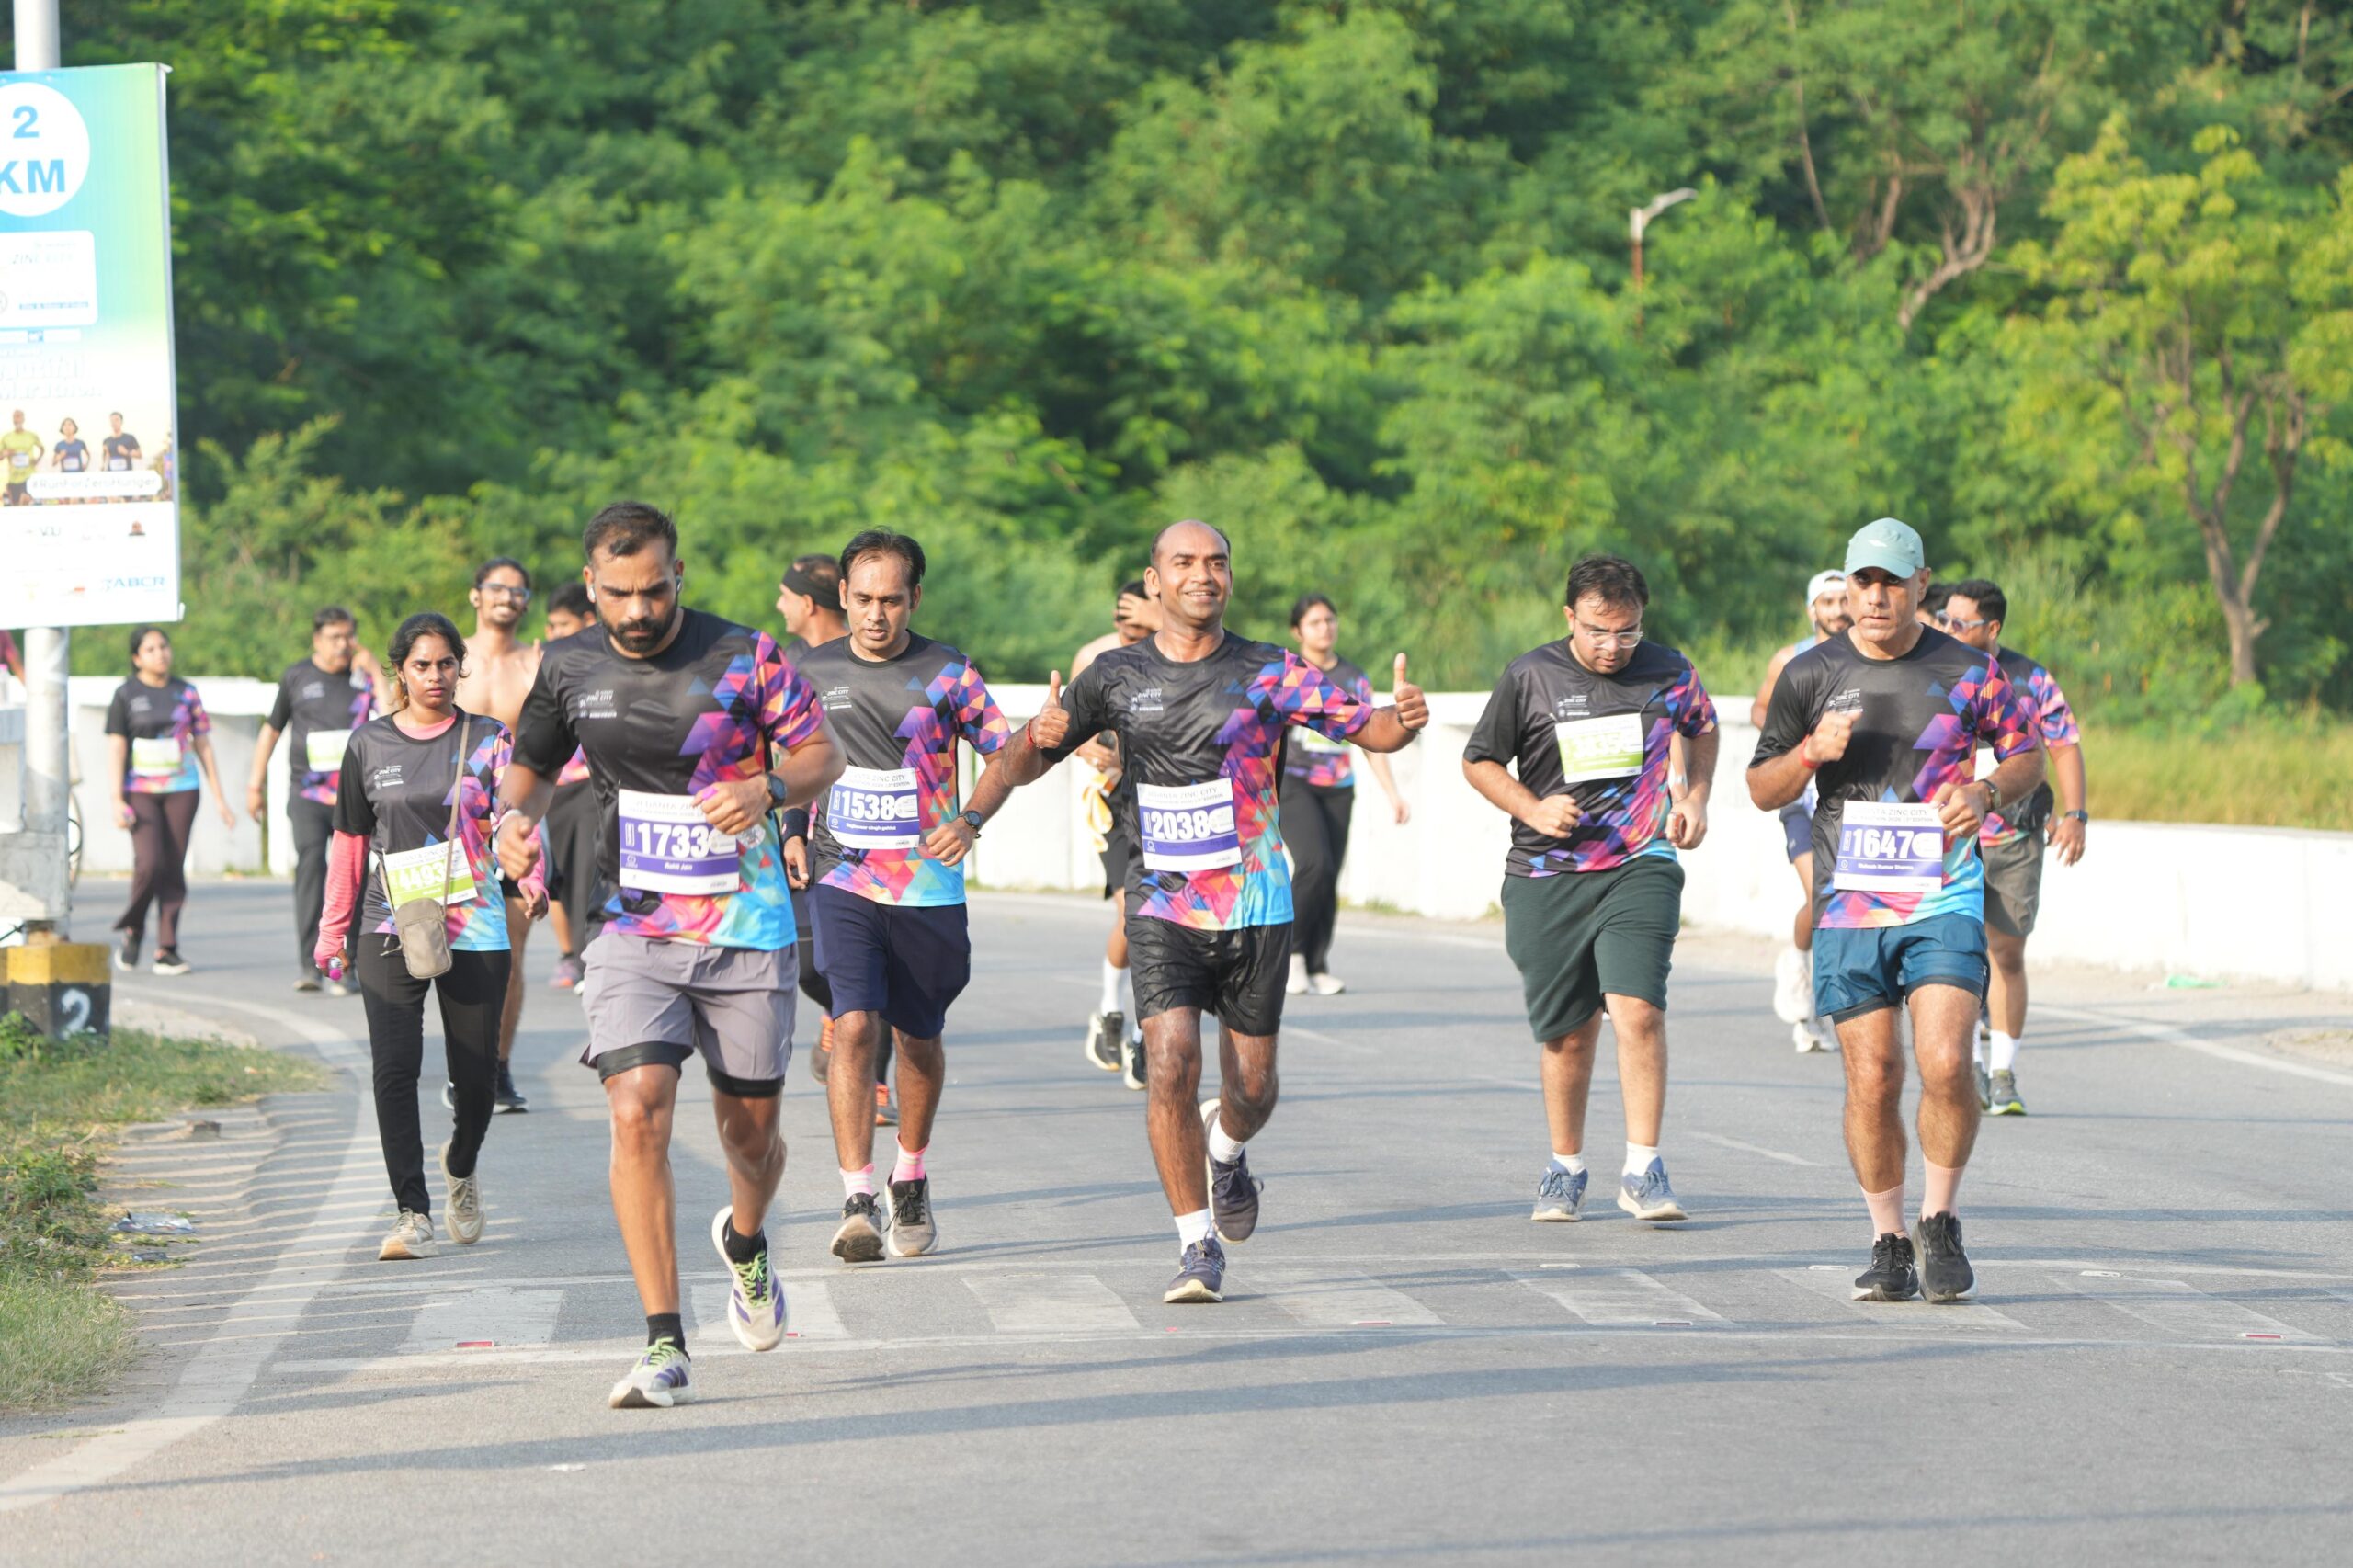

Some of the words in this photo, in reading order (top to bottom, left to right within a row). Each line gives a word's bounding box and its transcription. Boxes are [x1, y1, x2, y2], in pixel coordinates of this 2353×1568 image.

[12, 105, 40, 139] 2
[0, 159, 66, 194] KM
[842, 790, 895, 821] 1538
[637, 823, 710, 858] 1733
[1151, 810, 1211, 841] 2038
[1853, 828, 1915, 858] 1647
[61, 987, 97, 1041] 2
